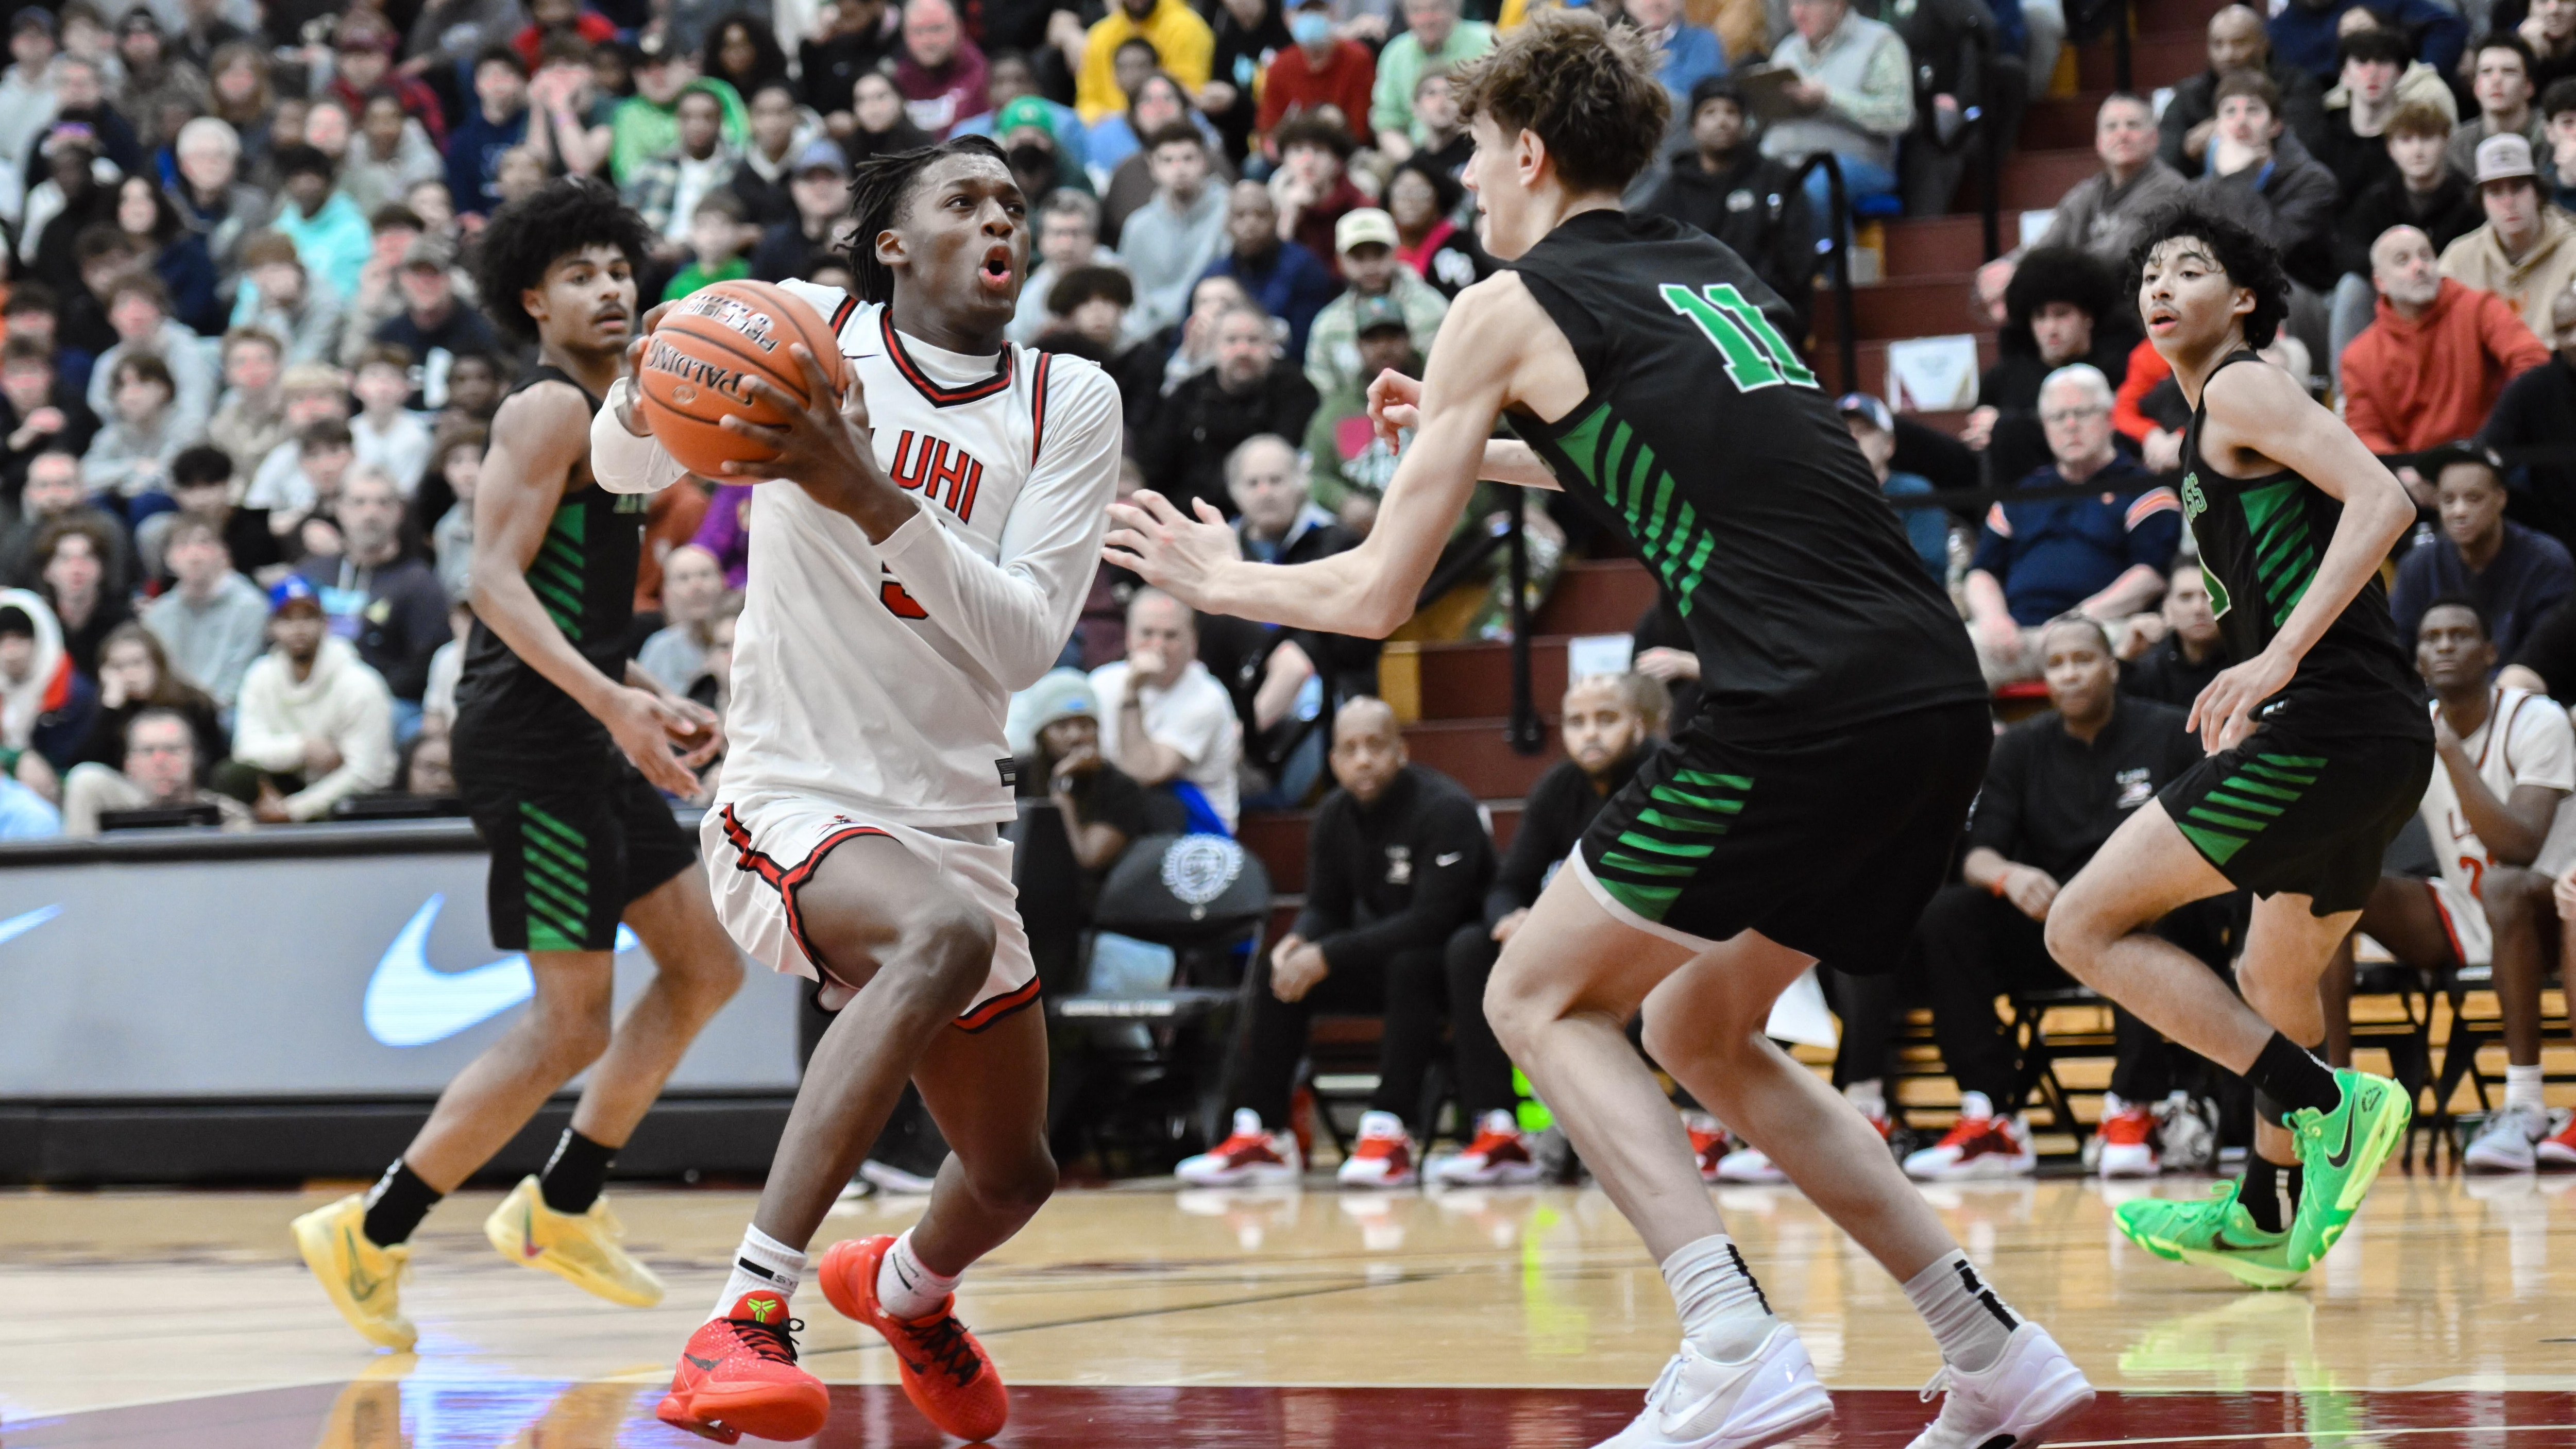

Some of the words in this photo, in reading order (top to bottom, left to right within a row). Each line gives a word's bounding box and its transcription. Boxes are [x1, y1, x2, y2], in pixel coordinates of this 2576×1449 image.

[1658, 283, 1820, 393] 11
[869, 428, 984, 525] UHI
[2181, 471, 2208, 524] SS
